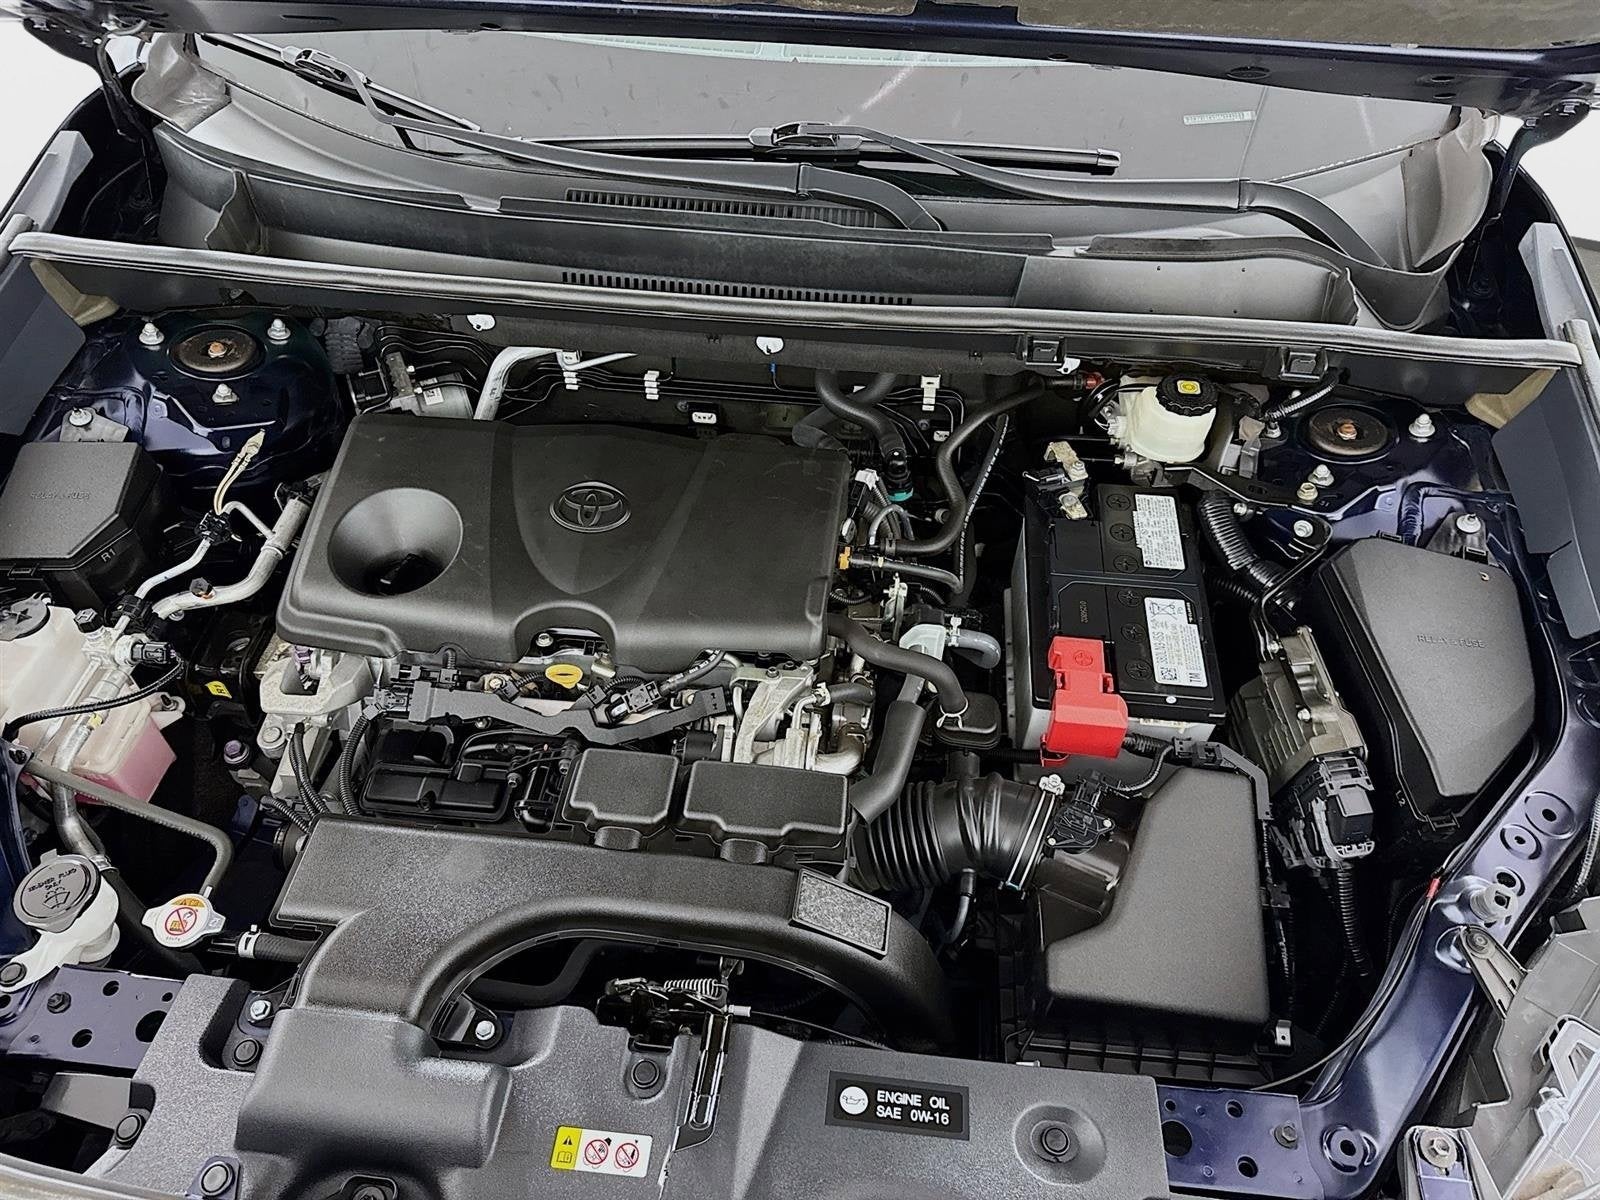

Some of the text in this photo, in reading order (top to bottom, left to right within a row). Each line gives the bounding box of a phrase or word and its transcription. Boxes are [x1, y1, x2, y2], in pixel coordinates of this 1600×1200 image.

[101, 548, 116, 561] R1
[877, 1090, 950, 1110] ENGINE OIL
[876, 1105, 950, 1125] SAE 0W-16
